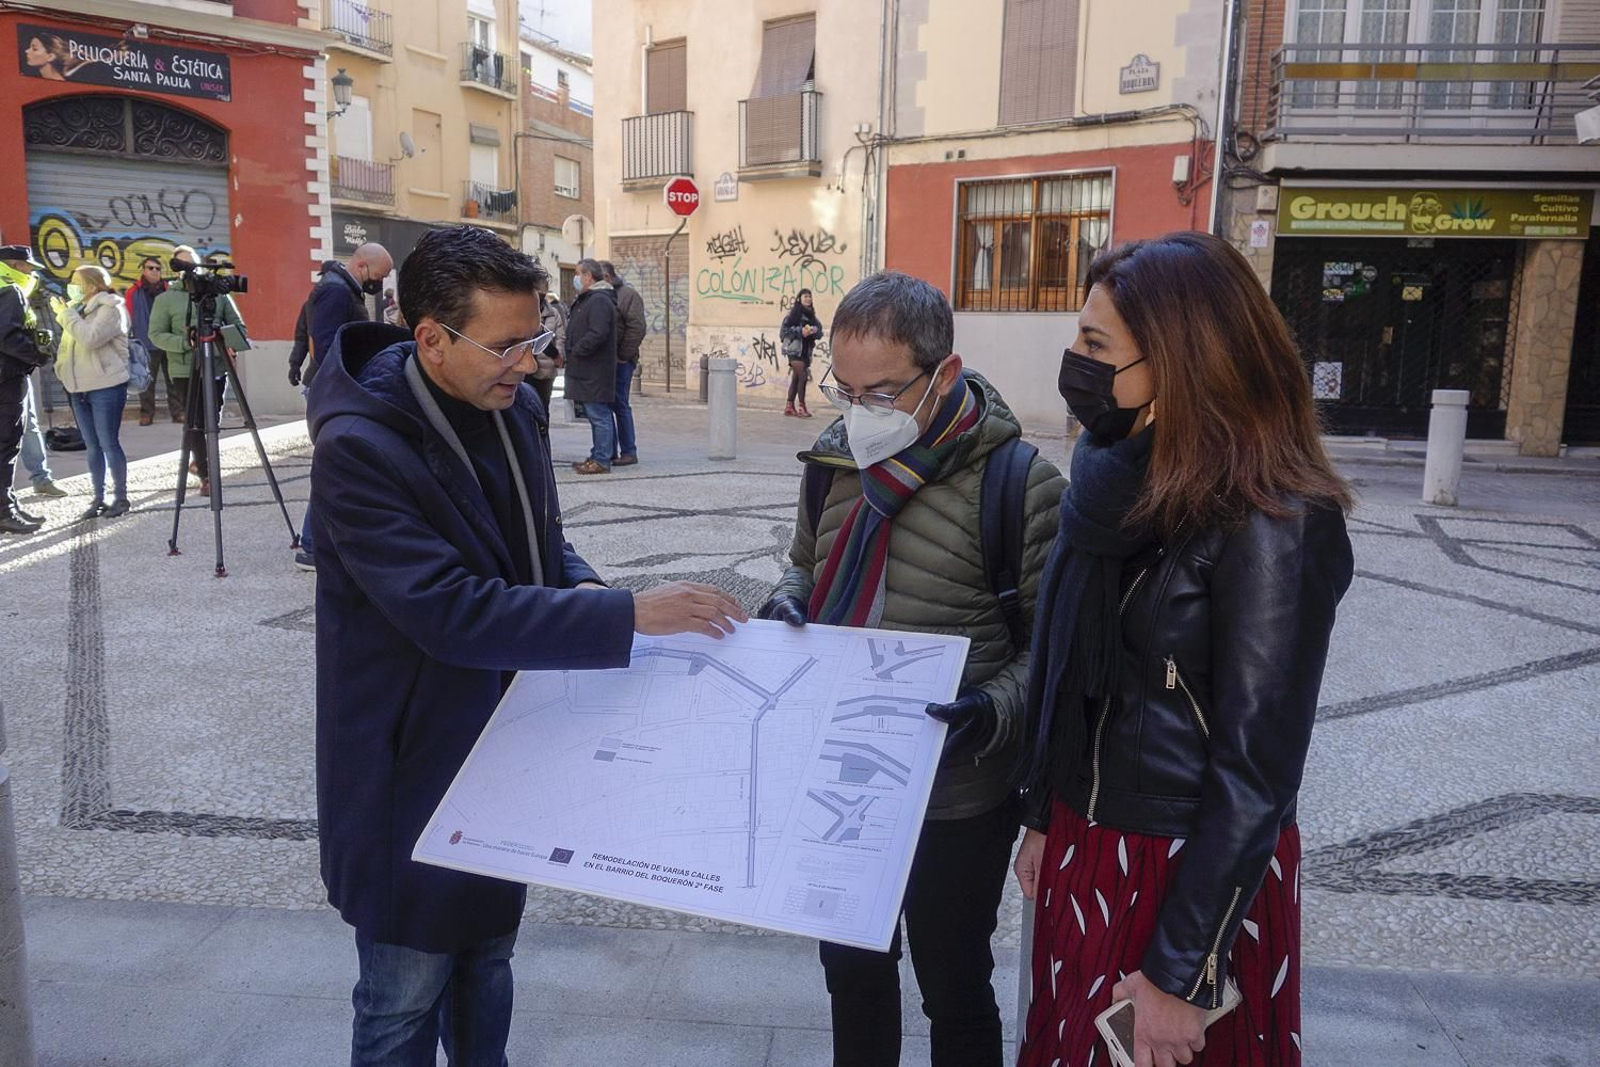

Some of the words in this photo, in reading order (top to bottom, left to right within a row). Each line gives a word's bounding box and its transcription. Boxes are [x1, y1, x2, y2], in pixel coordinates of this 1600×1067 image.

[113, 66, 151, 83] SANTA
[156, 72, 191, 89] PAULA
[154, 58, 166, 71] &
[171, 55, 223, 80] ESTÉTICA
[668, 191, 698, 203] STOP
[1533, 194, 1580, 203] Semillas
[1290, 195, 1407, 221] Grouch
[1510, 213, 1578, 223] Parafernalia
[1540, 204, 1579, 213] Cultivo
[1434, 214, 1496, 231] Grow
[591, 852, 651, 870] REMODELACIÓN
[650, 863, 662, 872] DE
[662, 865, 690, 877] VARIAS
[690, 870, 721, 882] CALLES
[583, 861, 595, 869] EN
[595, 863, 604, 871] EL
[605, 865, 635, 876] BARRIO
[634, 870, 650, 880] DEL
[650, 873, 694, 888] BOQUERÓN
[703, 883, 724, 894] FASE
